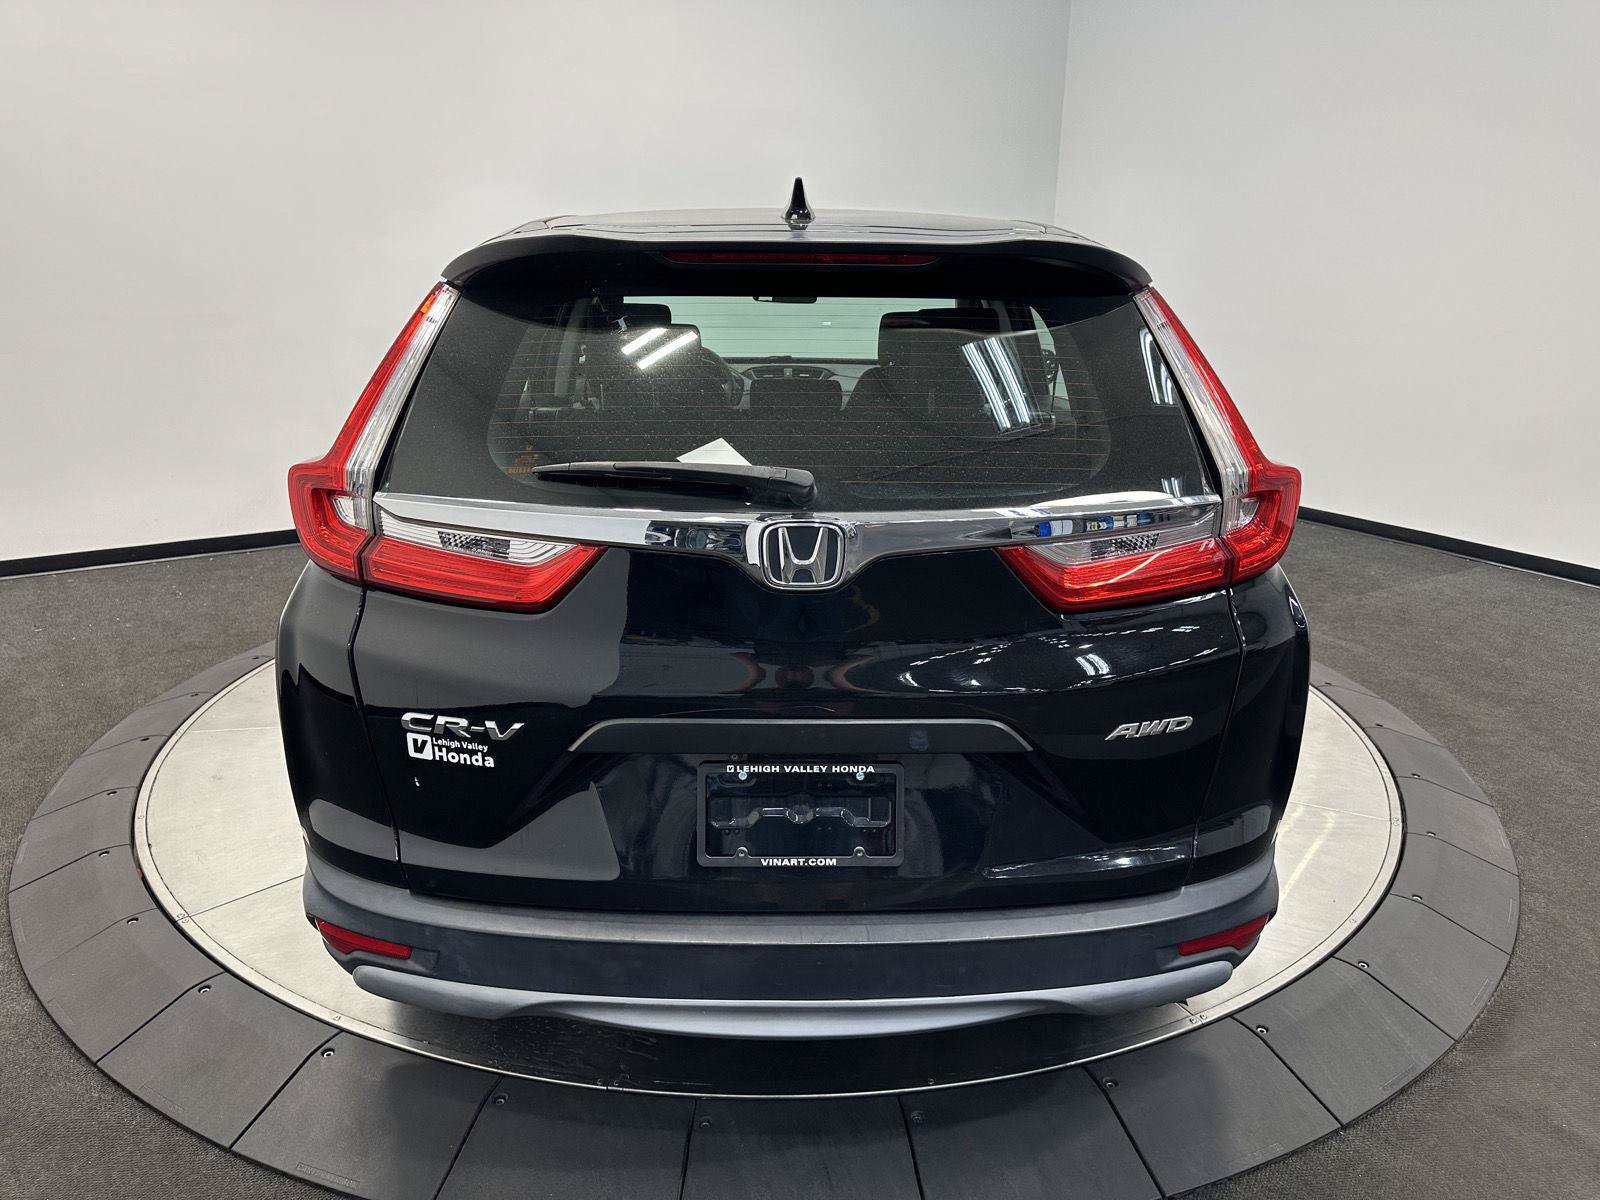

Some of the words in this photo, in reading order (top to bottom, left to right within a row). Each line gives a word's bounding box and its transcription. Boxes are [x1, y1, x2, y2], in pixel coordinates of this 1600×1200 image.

[401, 712, 525, 741] CR-V
[1104, 716, 1193, 740] AWD
[432, 737, 460, 749] Lehigh
[461, 741, 489, 753] Valley
[433, 746, 495, 768] Honda
[736, 765, 780, 773] LEHIGH
[783, 765, 828, 773] VALLEY
[832, 765, 876, 773] HONDA
[760, 858, 837, 867] VINART.COM
